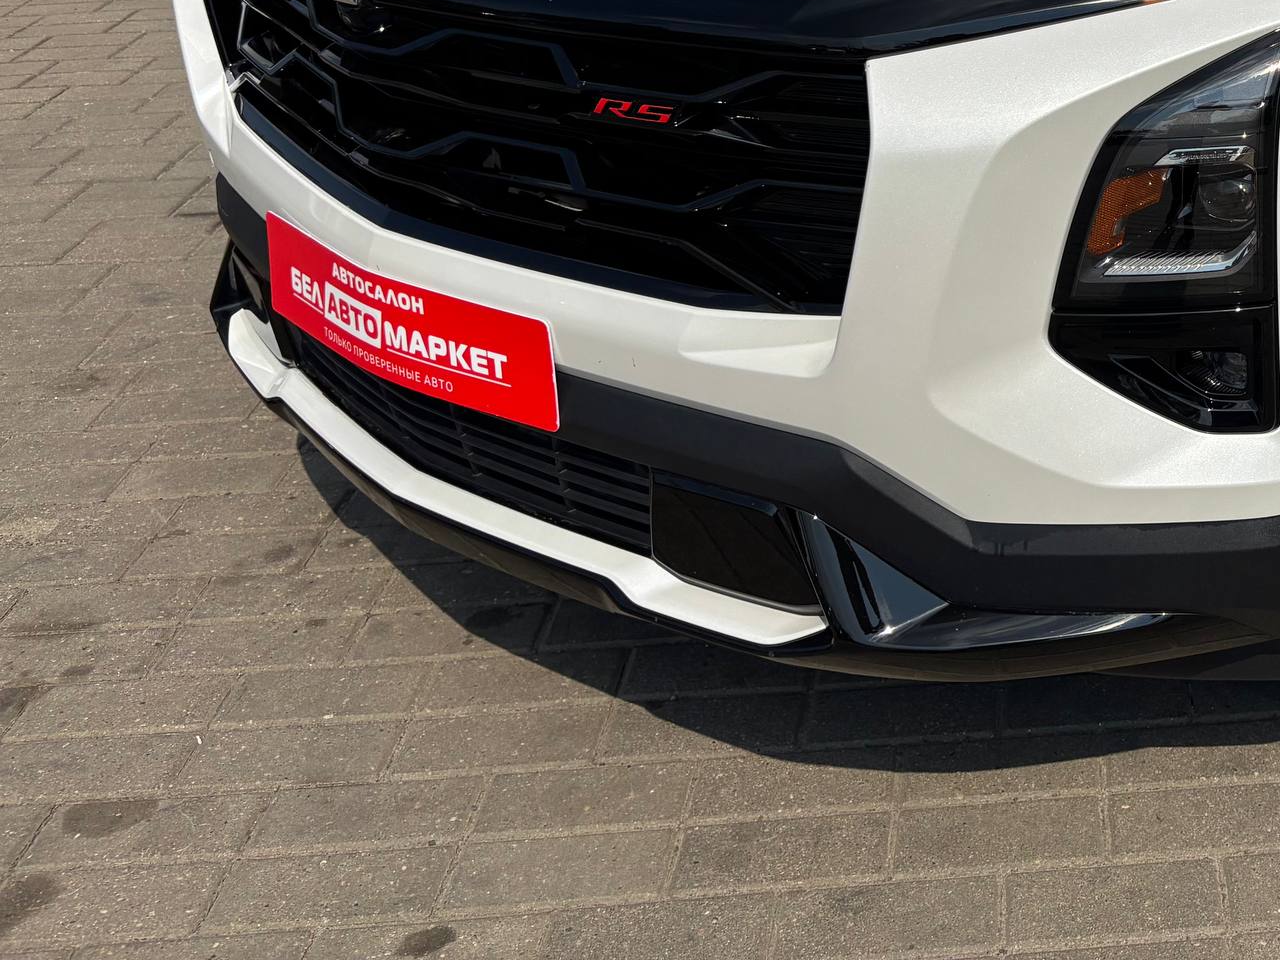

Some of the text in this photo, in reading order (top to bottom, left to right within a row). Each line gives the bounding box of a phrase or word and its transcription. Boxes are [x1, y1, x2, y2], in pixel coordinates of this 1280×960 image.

[593, 97, 673, 123] RS
[331, 262, 424, 316] АВТОСАЛОН
[323, 326, 454, 393] ТОЛЬКО ПРОВЕРЕННЫЕ АВТО
